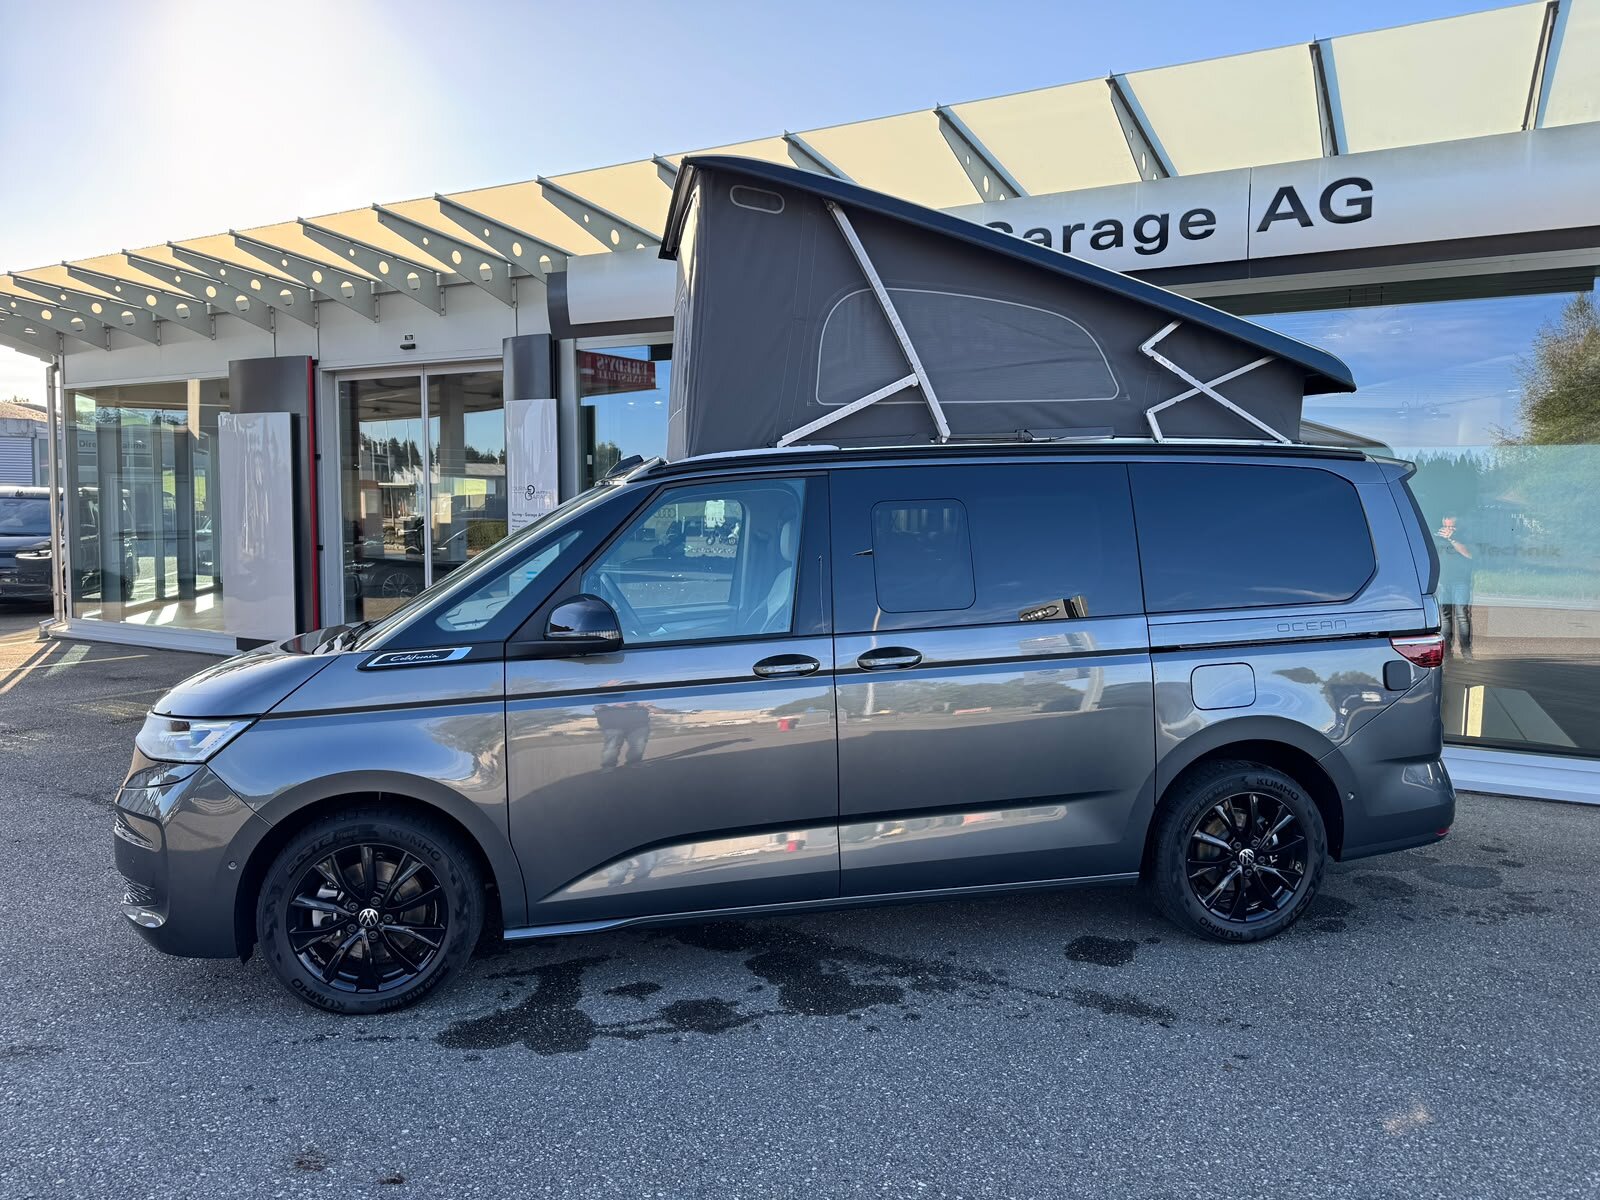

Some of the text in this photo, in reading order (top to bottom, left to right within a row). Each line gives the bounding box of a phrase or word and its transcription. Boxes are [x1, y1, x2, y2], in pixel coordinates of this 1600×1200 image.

[1256, 177, 1374, 233] AG
[1477, 542, 1561, 558] Technik
[1276, 619, 1348, 633] OCEAN
[390, 653, 440, 662] California
[1256, 777, 1300, 801] KUMHO
[387, 828, 443, 863] KUMHO
[1200, 916, 1245, 940] KUMHO
[291, 978, 348, 1011] KUMHO
